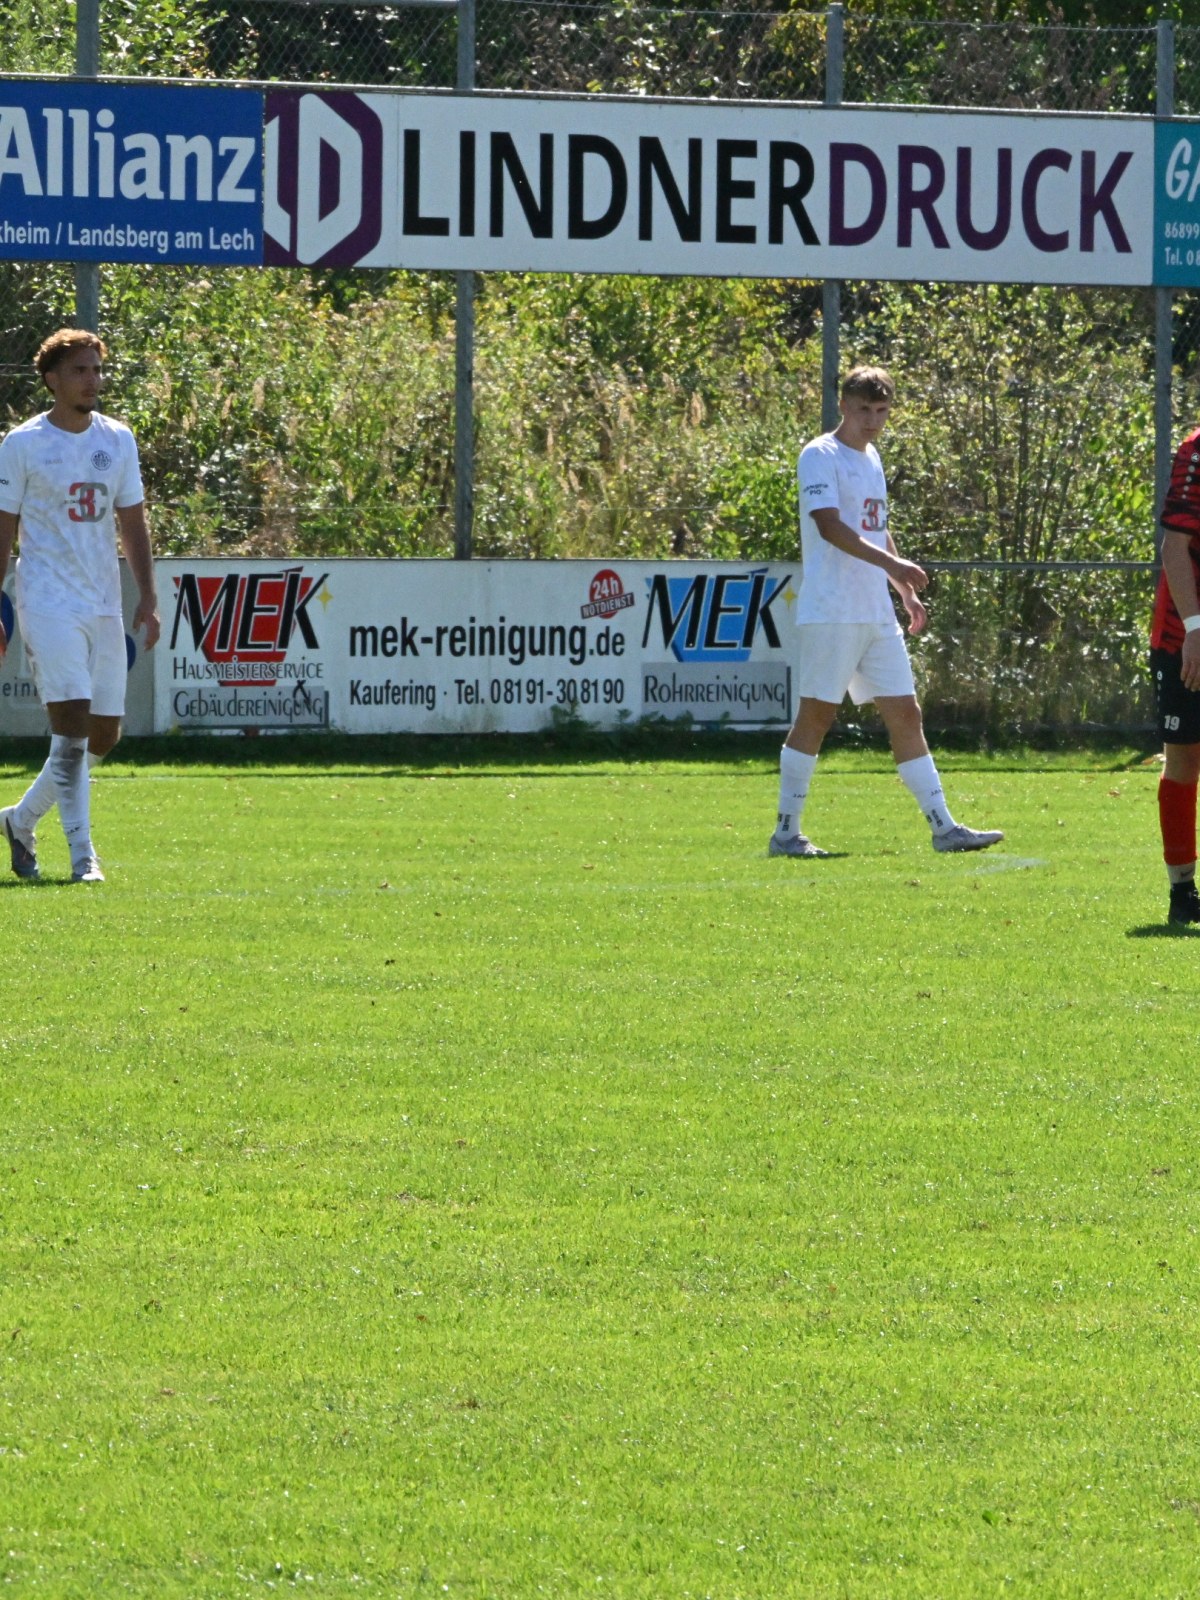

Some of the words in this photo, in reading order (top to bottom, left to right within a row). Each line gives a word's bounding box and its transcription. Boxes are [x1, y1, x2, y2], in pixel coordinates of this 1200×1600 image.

[0, 106, 256, 203] Allianz
[68, 223, 169, 254] Landsberg
[175, 230, 203, 249] am
[209, 227, 255, 250] Lech
[1164, 222, 1200, 239] 86899
[1164, 246, 1183, 265] Tel.
[592, 577, 620, 600] 24h
[169, 566, 330, 651] MEK
[582, 593, 633, 618] NOTDIENST
[641, 567, 793, 650] MEK
[350, 616, 625, 666] mek-reinigung.de
[350, 679, 436, 711] Kaufering
[454, 679, 485, 705] Tel.
[1163, 715, 1180, 731] 19
